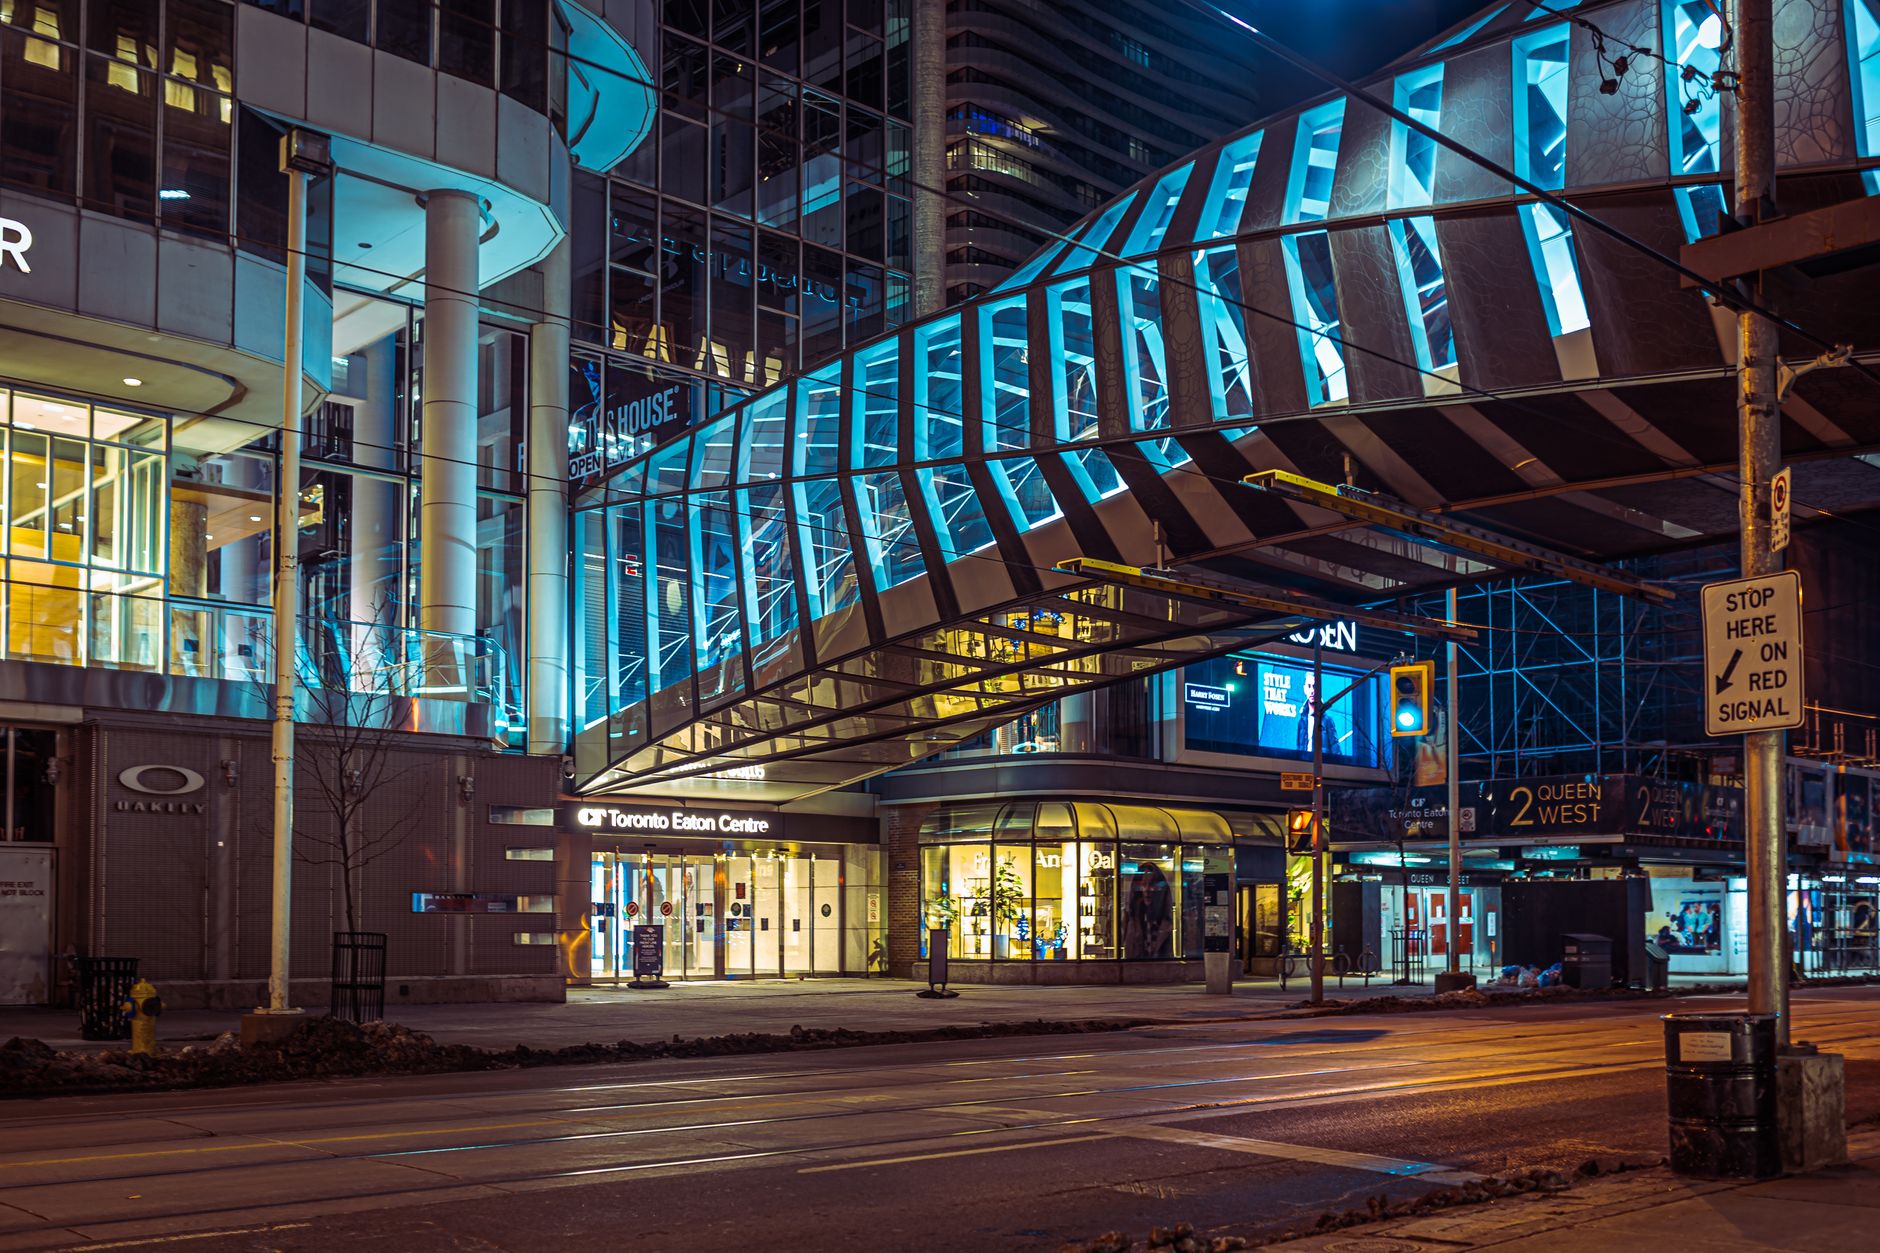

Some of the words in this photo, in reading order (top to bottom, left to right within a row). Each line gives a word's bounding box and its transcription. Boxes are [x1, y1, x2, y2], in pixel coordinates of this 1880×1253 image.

[587, 410, 615, 449] THS
[570, 454, 600, 477] OPEN
[1725, 587, 1775, 613] STOP
[1726, 614, 1777, 640] HERE
[1760, 641, 1788, 663] ON
[1264, 672, 1291, 689] STYLE
[1748, 669, 1788, 692] RED
[1264, 686, 1288, 703] THAT
[1264, 700, 1297, 718] WORKS
[1718, 697, 1790, 723] SIGNAL
[1411, 797, 1427, 808] CF
[1538, 783, 1603, 801] QUEEN
[1388, 809, 1422, 819] Toronto
[1423, 808, 1450, 818] Eaton
[1510, 786, 1535, 827] 2
[1538, 803, 1602, 825] WEST
[1637, 785, 1651, 826] 2
[608, 809, 670, 830] Toronto
[672, 812, 716, 831] Eaton
[718, 814, 770, 834] Centre
[1404, 819, 1434, 829] Centre
[1410, 873, 1435, 884] QUEEN
[1446, 875, 1470, 885] SEET
[19, 889, 46, 897] BLOCK
